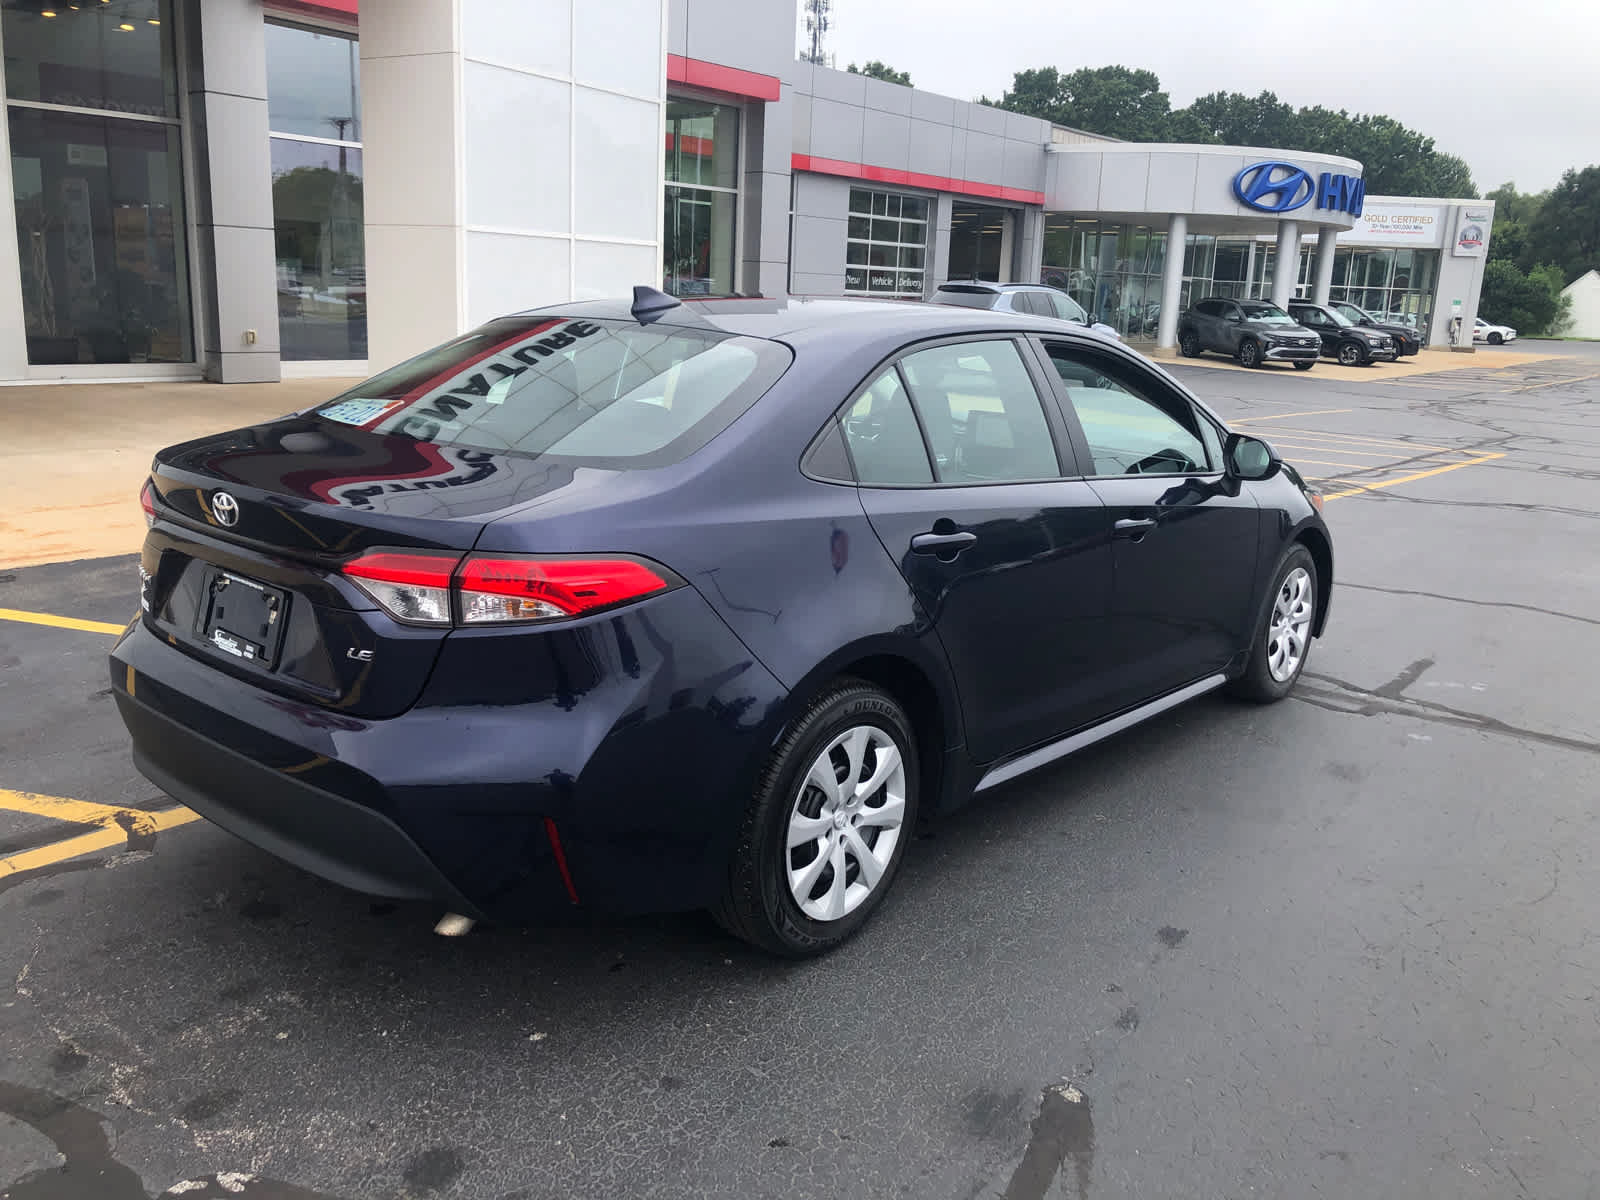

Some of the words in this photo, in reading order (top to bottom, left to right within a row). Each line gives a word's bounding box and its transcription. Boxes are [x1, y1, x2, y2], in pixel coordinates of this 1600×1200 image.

[1364, 213, 1388, 223] GOLD
[1391, 214, 1433, 225] CERTIFIED
[846, 274, 860, 285] New
[871, 275, 893, 287] Vehicle
[898, 278, 922, 289] Delivery
[346, 647, 374, 662] LE
